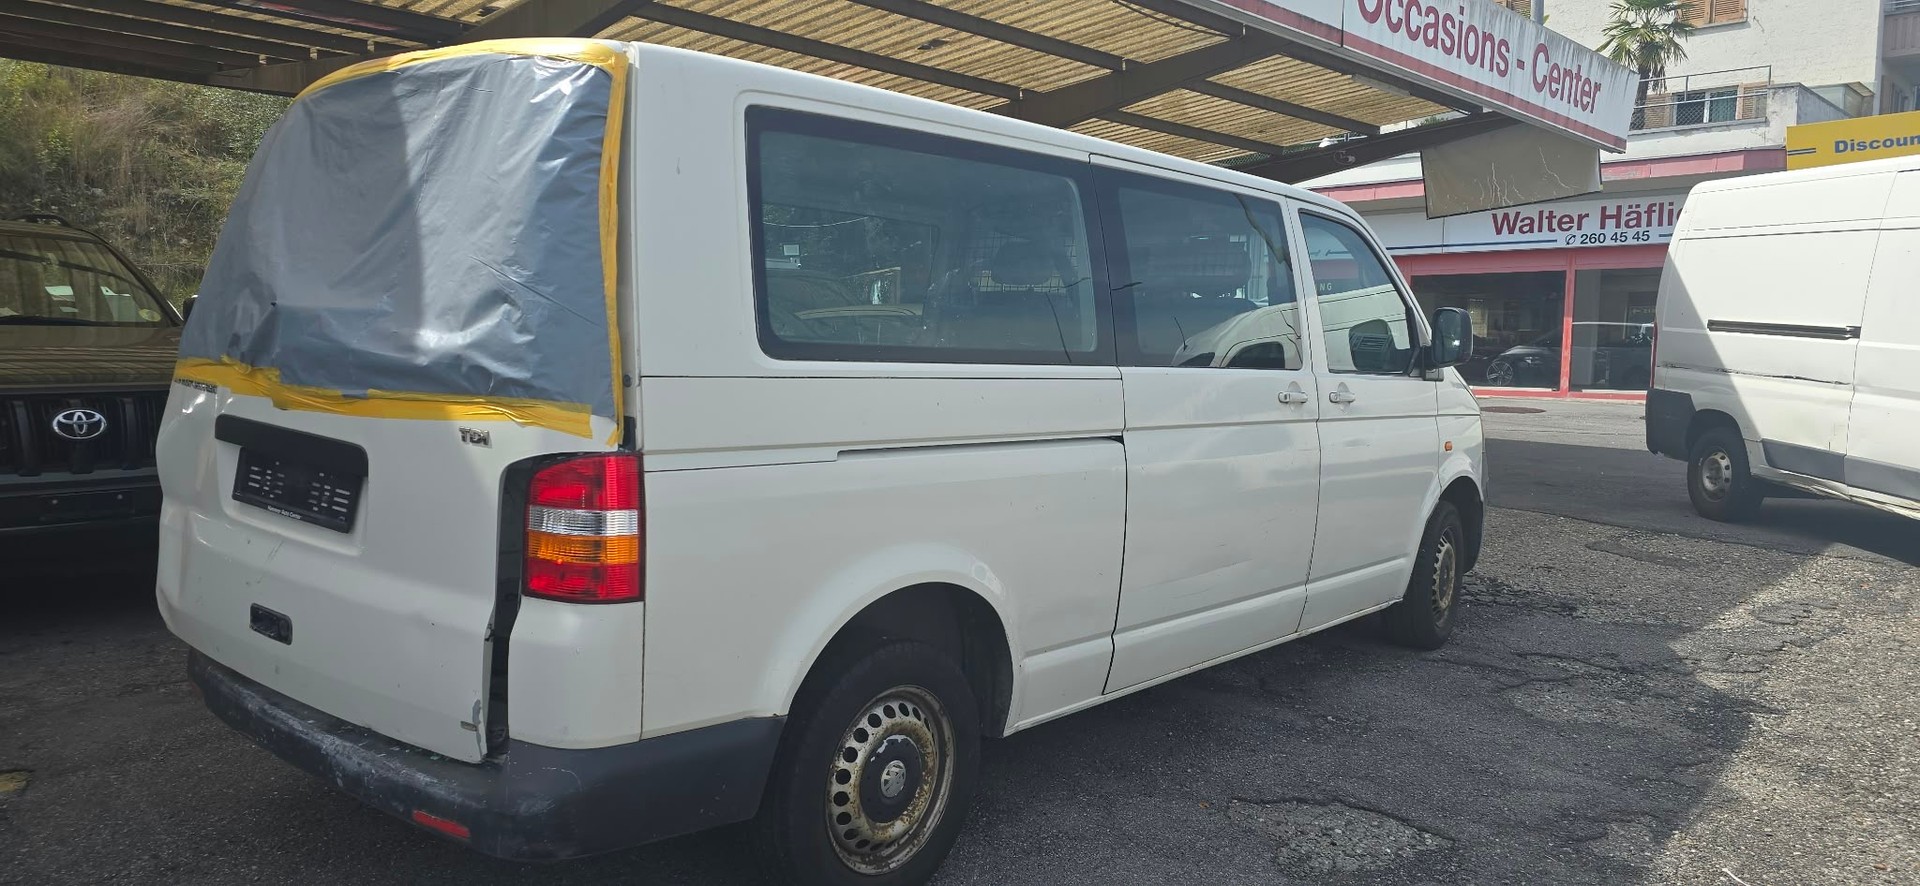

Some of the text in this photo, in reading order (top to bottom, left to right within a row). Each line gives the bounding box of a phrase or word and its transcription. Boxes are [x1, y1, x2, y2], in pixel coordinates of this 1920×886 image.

[1532, 43, 1601, 114] Center
[1834, 134, 1920, 153] Discoun
[1491, 201, 1683, 236] Walter Häfli
[1580, 230, 1650, 245] 260 45 45
[459, 426, 491, 446] TDI
